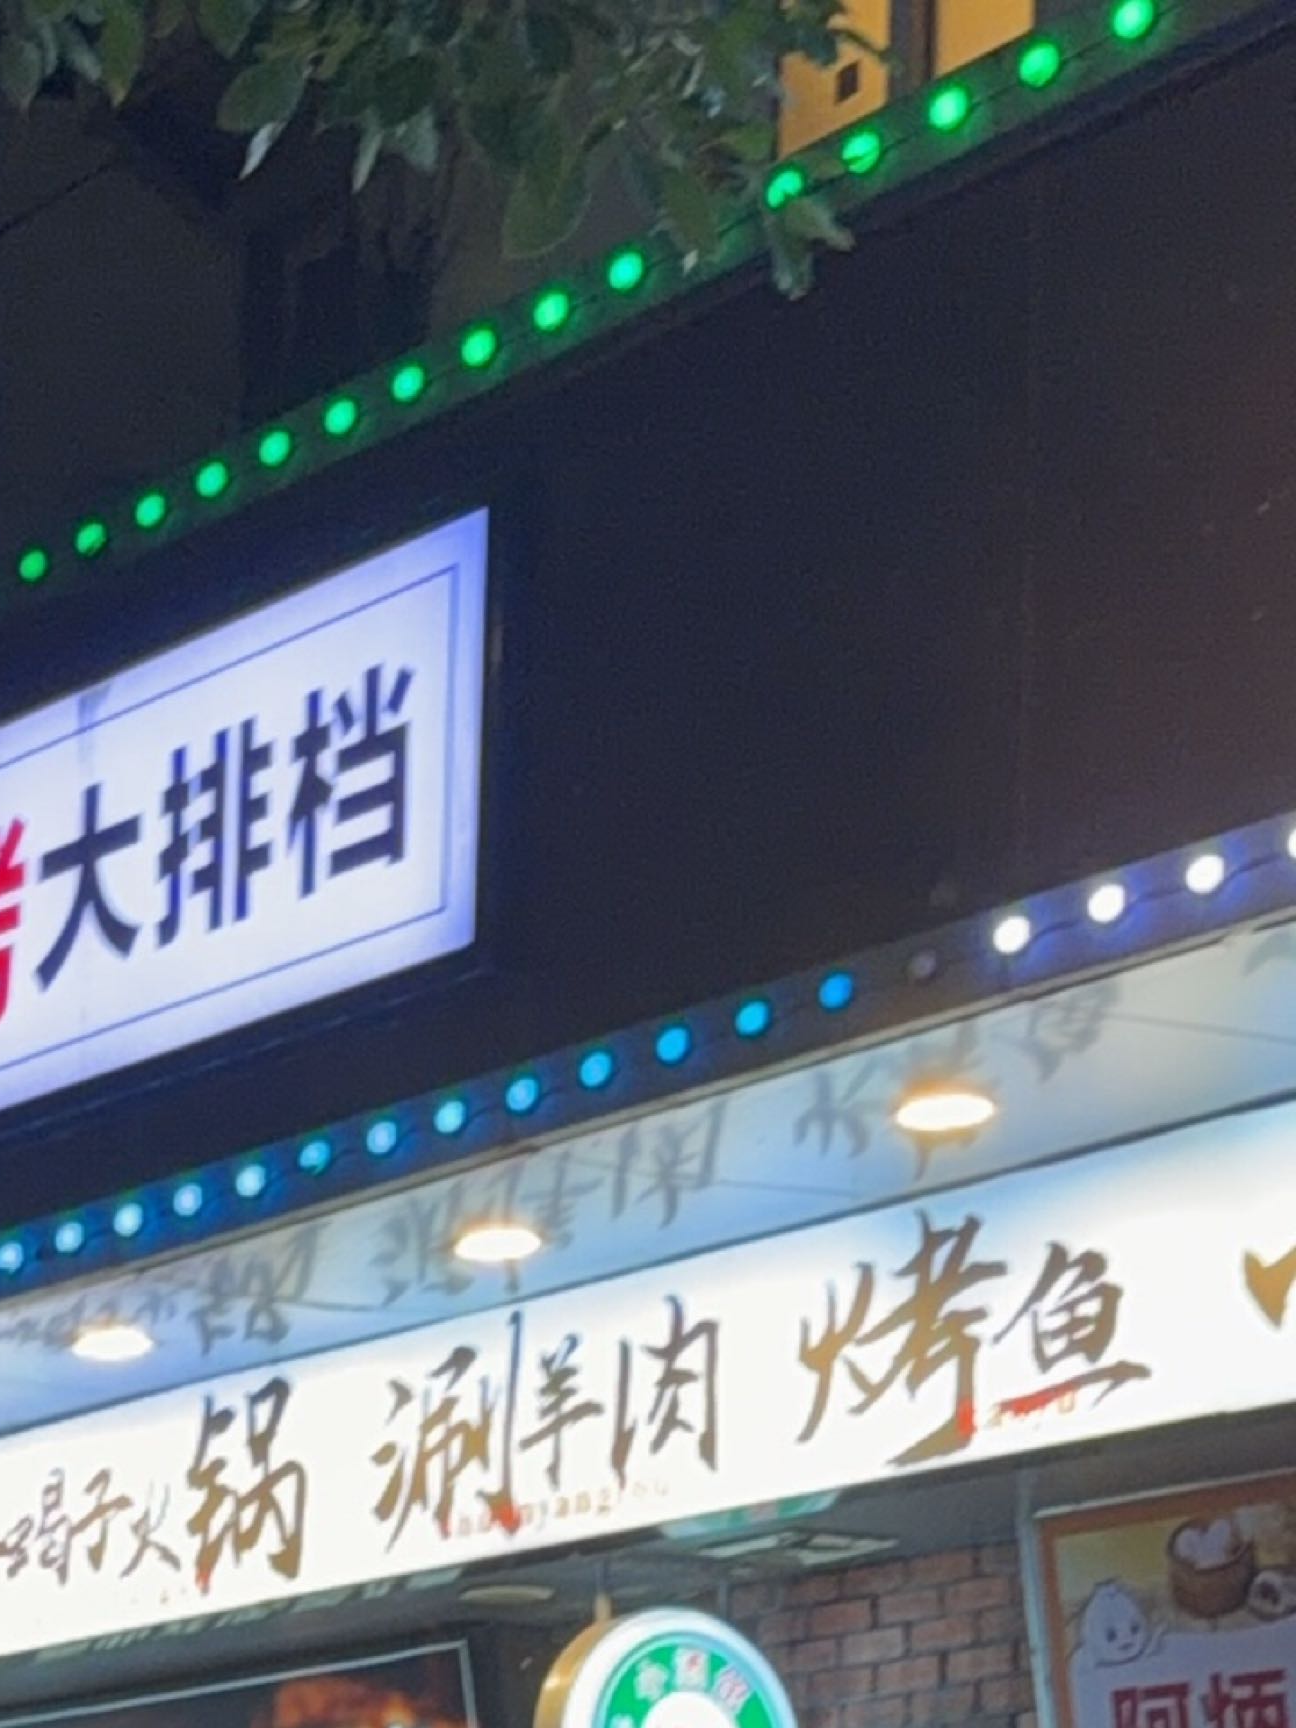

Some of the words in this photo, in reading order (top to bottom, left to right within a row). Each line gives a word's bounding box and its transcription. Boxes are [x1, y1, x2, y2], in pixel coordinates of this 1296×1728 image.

[370, 1294, 720, 1554] 涮羊肉
[794, 1206, 1152, 1466] 烤鱼
